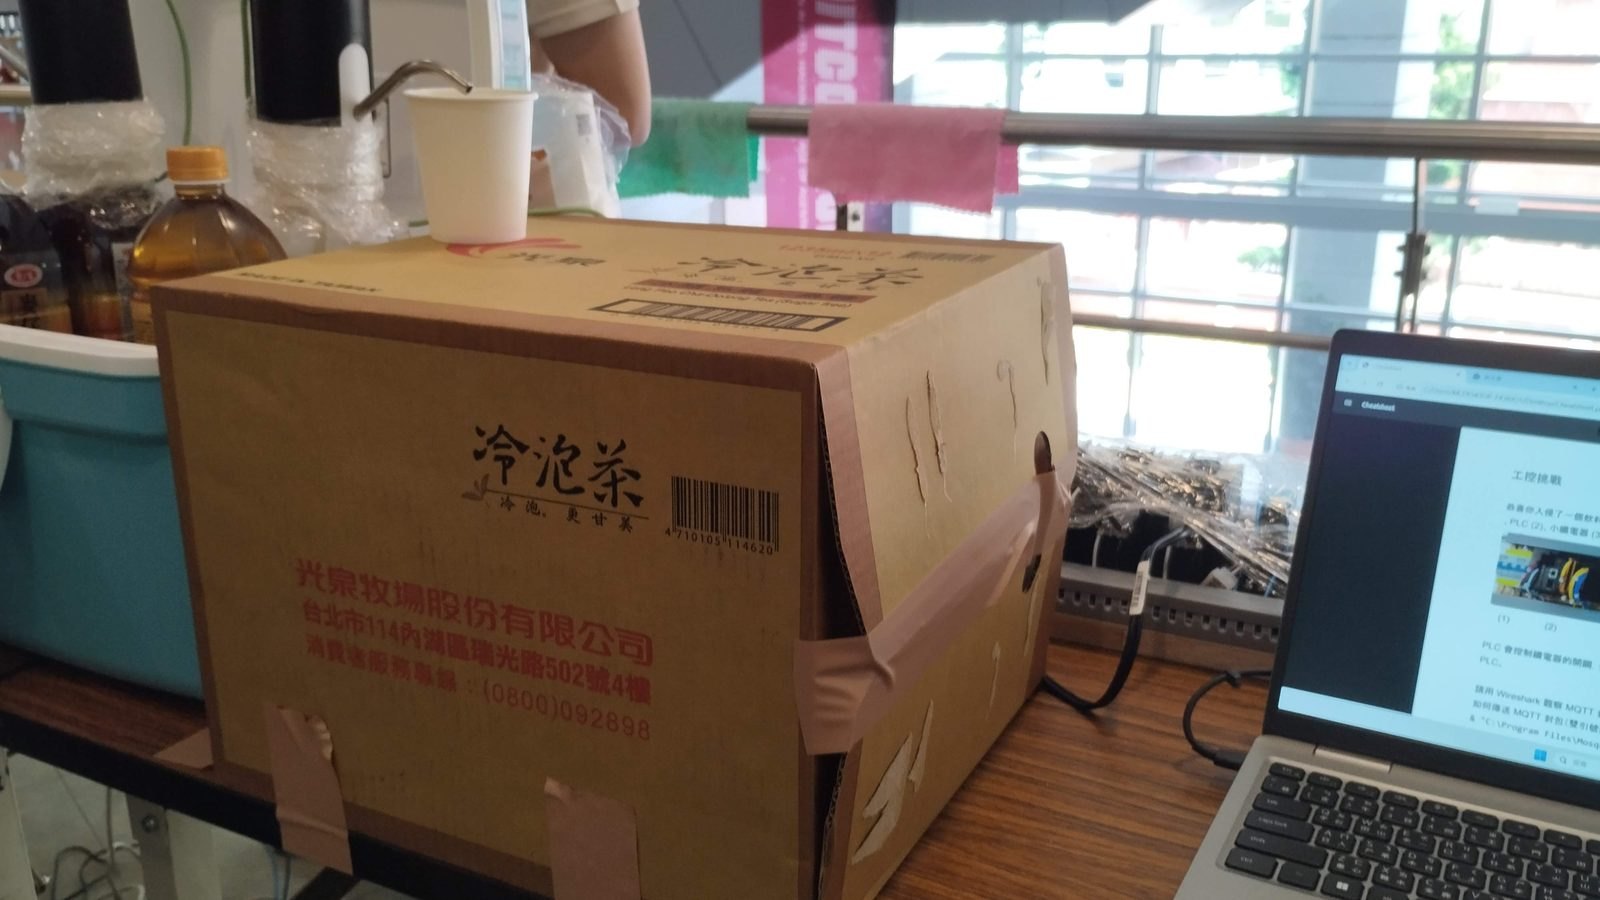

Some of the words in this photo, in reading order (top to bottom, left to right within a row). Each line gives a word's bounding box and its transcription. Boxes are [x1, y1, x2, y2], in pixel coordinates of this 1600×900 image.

[473, 424, 644, 508] 冷泡茶
[665, 527, 671, 537] 4
[677, 529, 721, 546] 710105
[728, 538, 774, 555] 114620
[296, 558, 653, 667] 光泉牧場股份有限公司
[1482, 640, 1502, 652] PLC
[1513, 708, 1541, 721] MQTT
[1565, 703, 1595, 715] MQTT
[1544, 730, 1600, 750] Files\Mosq
